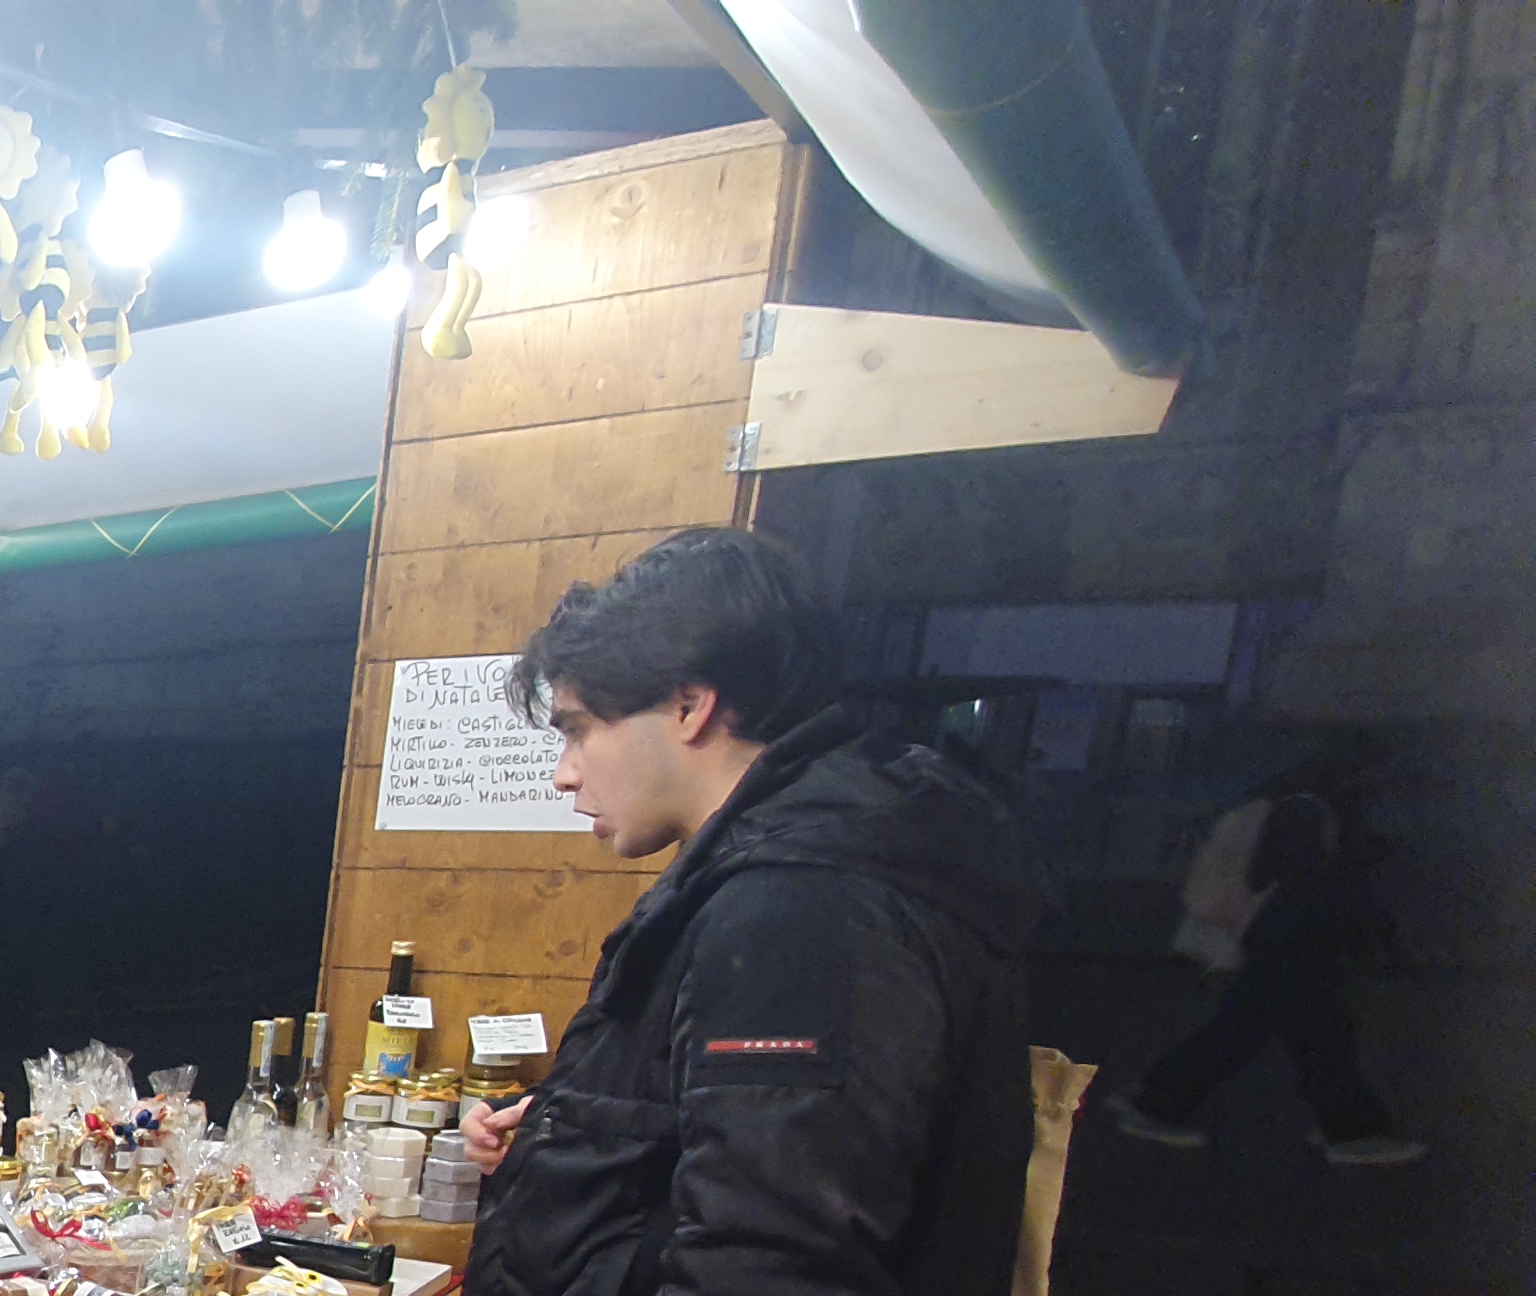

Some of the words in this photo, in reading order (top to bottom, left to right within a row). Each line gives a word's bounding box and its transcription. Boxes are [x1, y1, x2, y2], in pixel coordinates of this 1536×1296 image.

[408, 661, 455, 687] PER
[406, 688, 425, 704] DI
[427, 685, 505, 710] NATALE
[392, 717, 426, 732] MIELE
[464, 737, 528, 749] ZENZERO
[390, 755, 464, 772] LIQUIRIZIA
[390, 774, 419, 790] RUM
[386, 794, 462, 808] MELOGRANO
[478, 788, 564, 804] MANDARINO
